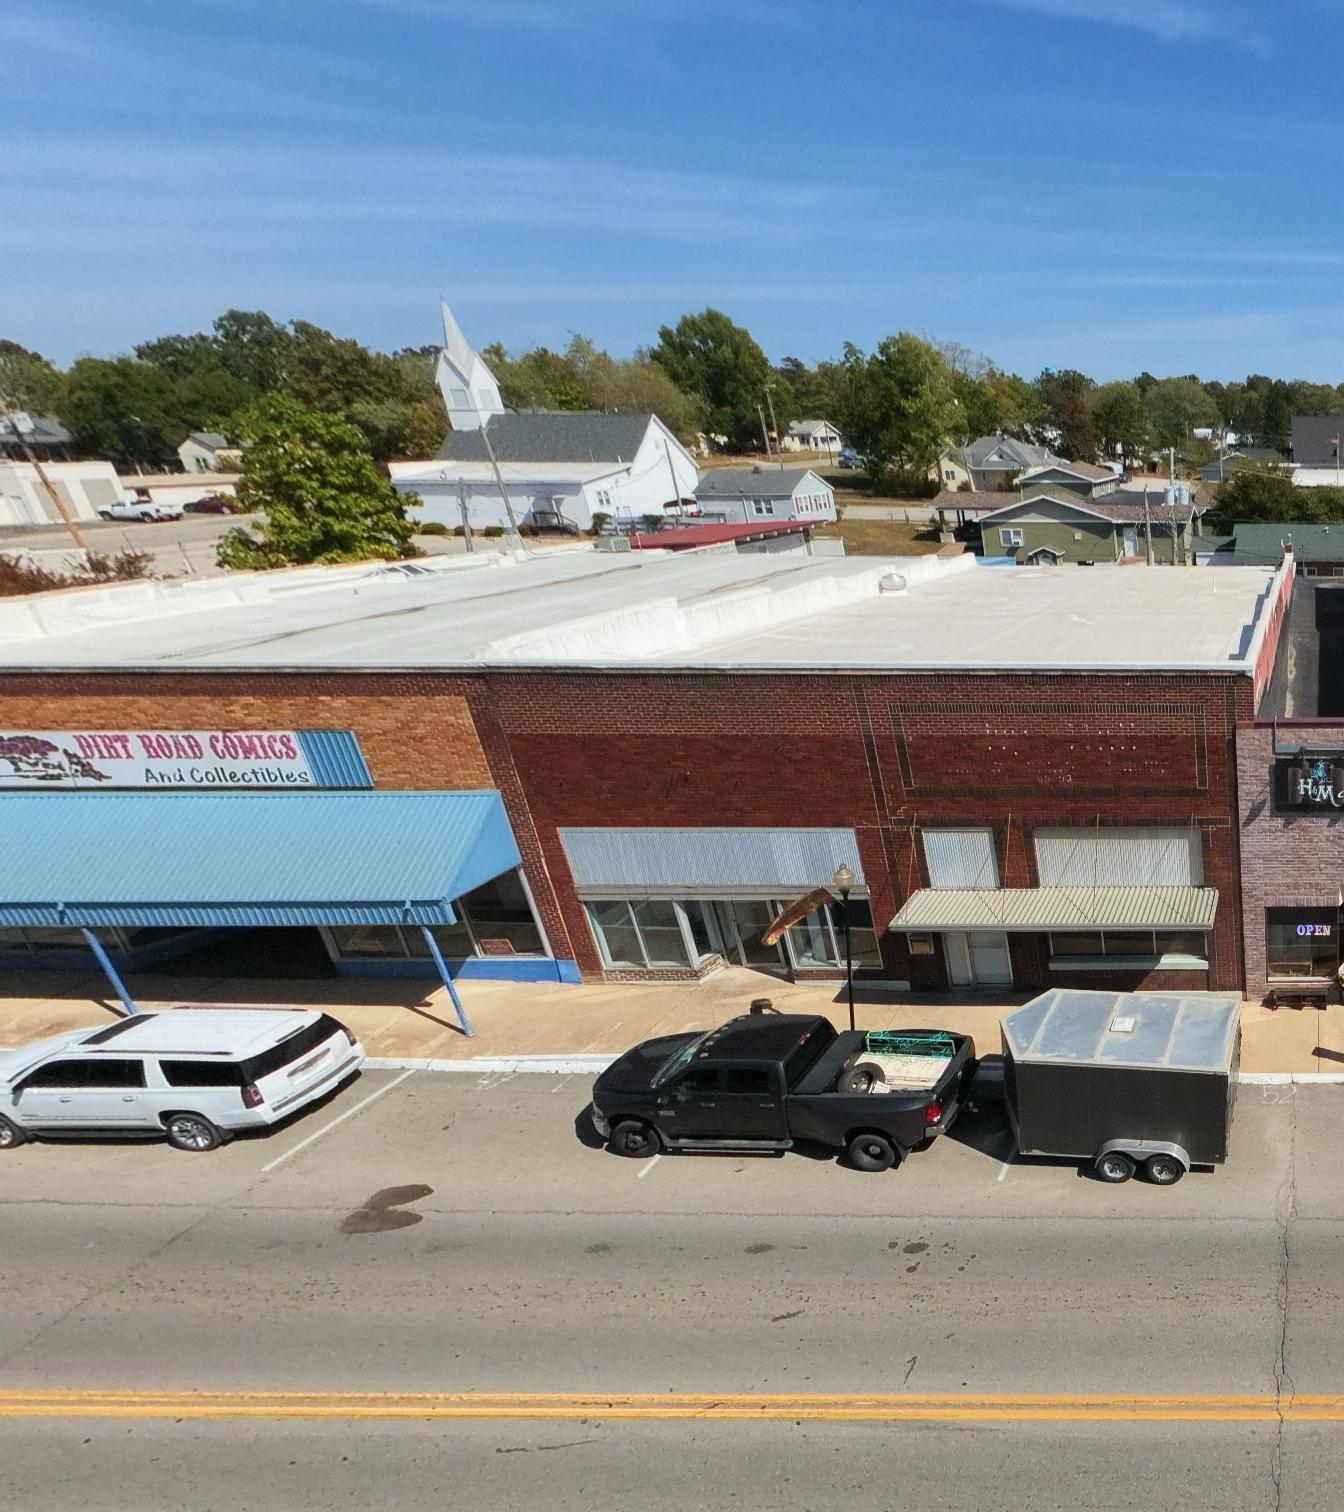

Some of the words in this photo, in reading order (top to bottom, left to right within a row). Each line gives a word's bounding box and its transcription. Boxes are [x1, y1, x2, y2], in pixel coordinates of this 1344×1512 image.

[73, 734, 134, 760] DIRT
[137, 734, 205, 760] ROAD
[208, 733, 298, 760] COMICS
[145, 768, 186, 783] And
[190, 767, 310, 784] Collectibles
[1296, 924, 1332, 937] OPEN
